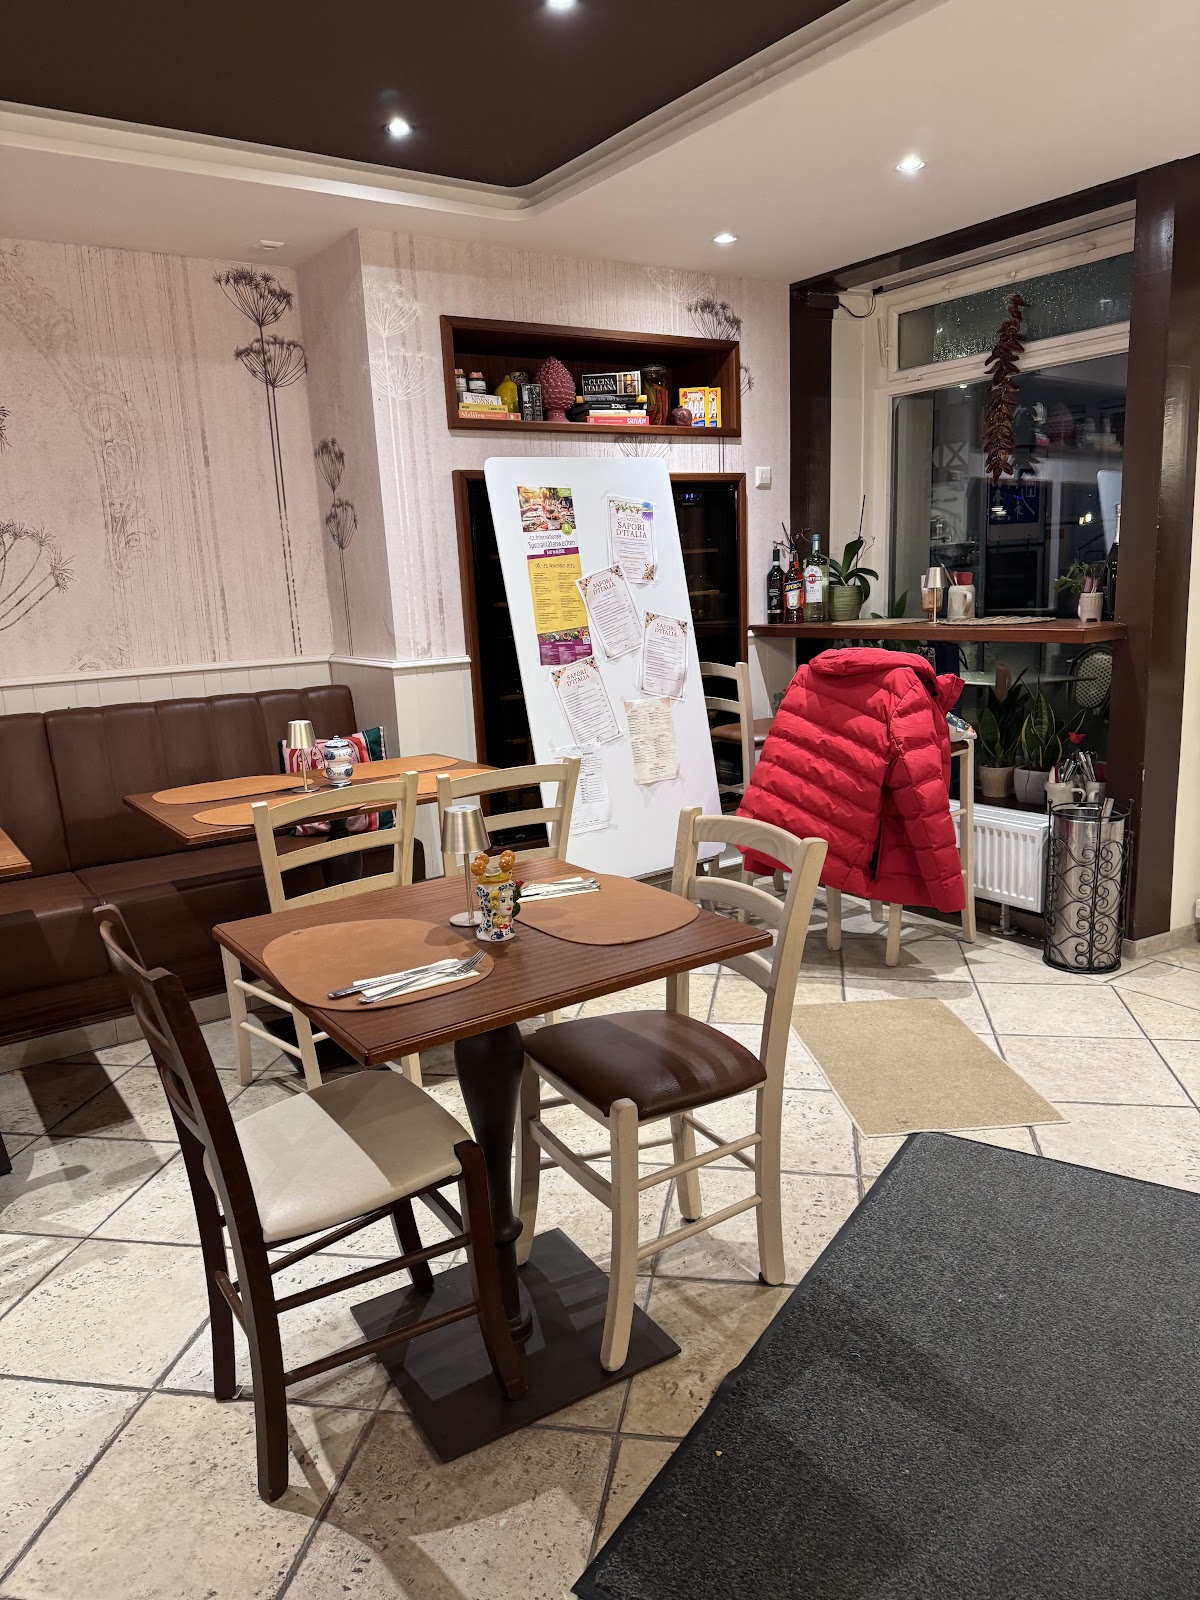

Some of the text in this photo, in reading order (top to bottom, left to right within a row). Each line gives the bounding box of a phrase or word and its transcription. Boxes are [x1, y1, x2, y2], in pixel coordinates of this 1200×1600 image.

[584, 384, 617, 392] ITALIANA
[617, 521, 646, 532] SAPORI
[616, 528, 648, 538] D'ITALIA
[592, 577, 613, 589] SAPORI
[785, 583, 802, 591] APEROL
[592, 583, 616, 595] D'ITALIA
[654, 627, 678, 637] D'ITALIA
[656, 622, 677, 632] SAPORI
[566, 669, 587, 681] SAPORI
[566, 674, 590, 687] D'ITALIA
